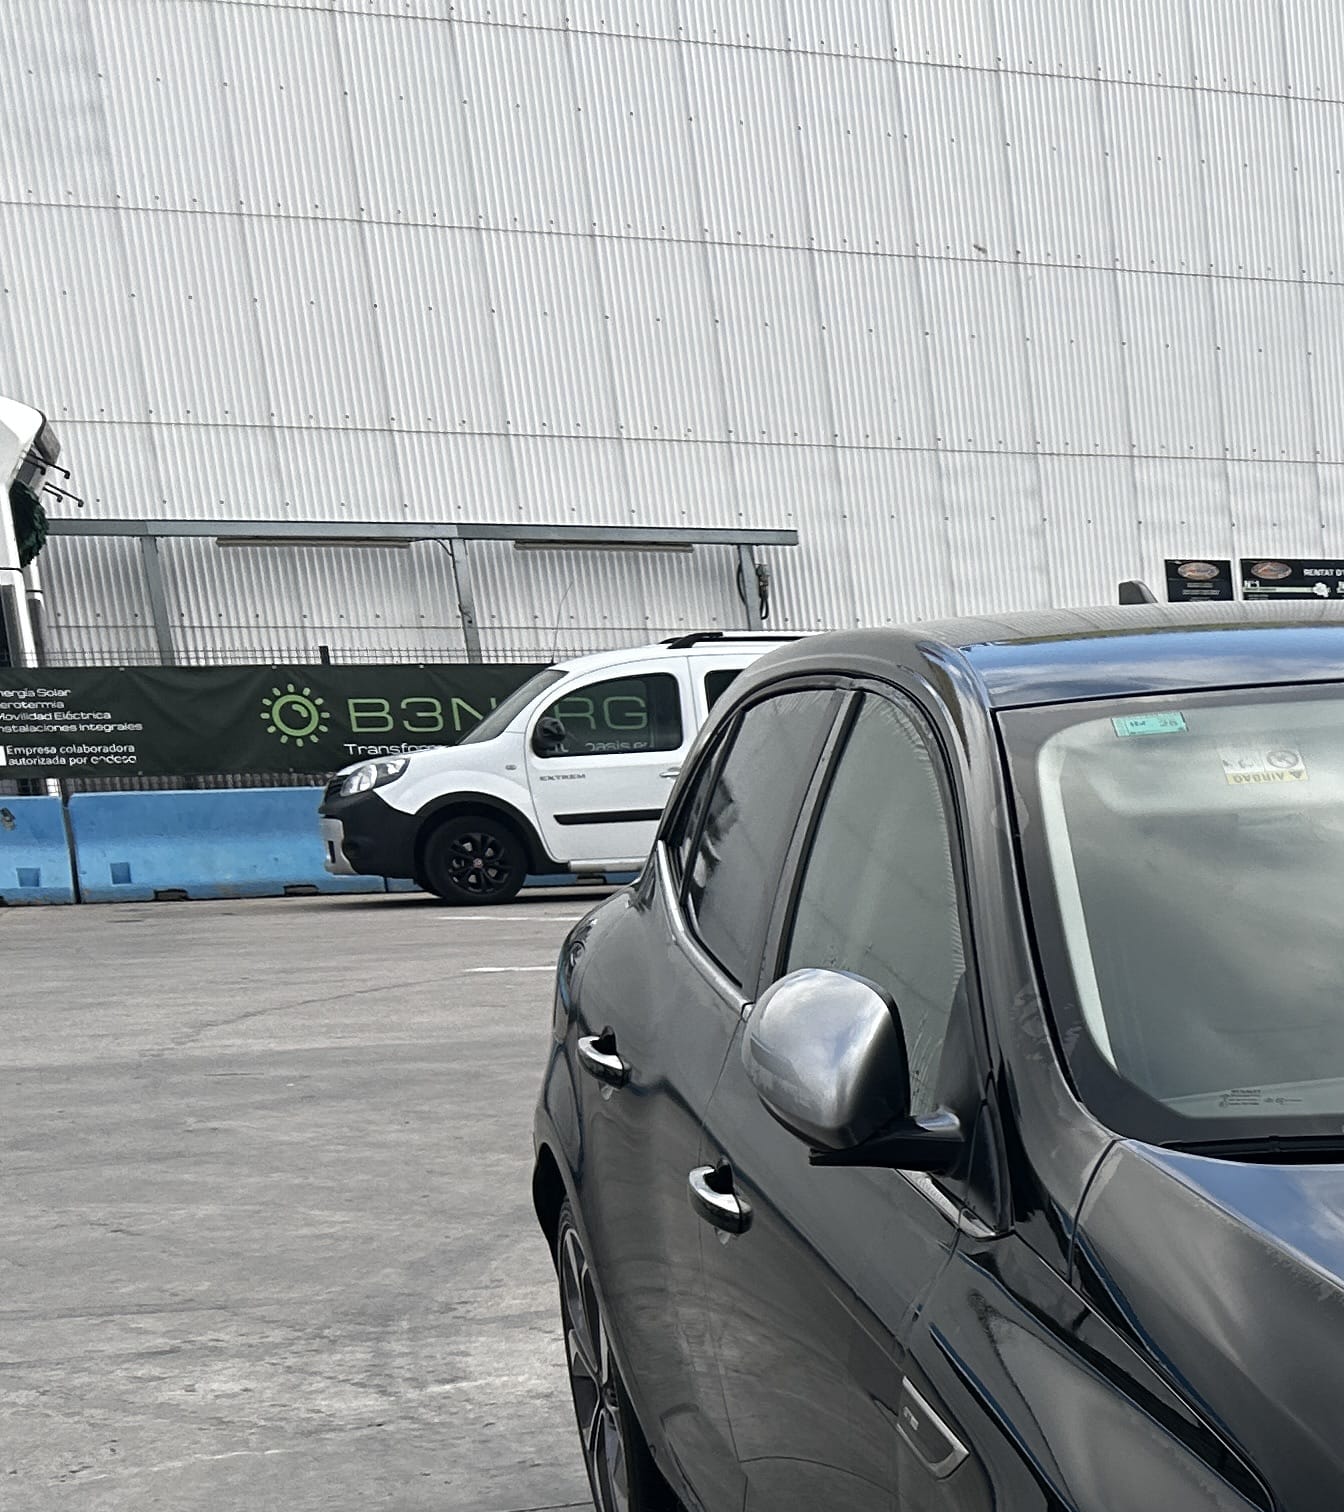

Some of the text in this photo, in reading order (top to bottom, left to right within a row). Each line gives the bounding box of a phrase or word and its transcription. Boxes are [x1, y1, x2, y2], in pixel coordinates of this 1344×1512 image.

[37, 688, 71, 698] Solar
[0, 701, 64, 709] erotermia
[54, 710, 112, 720] Eléctrica
[347, 695, 648, 733] B3NRG
[0, 723, 143, 733] nstalaciones Integrales
[6, 744, 135, 756] Empresa colaboradora
[8, 756, 66, 766] autorizada
[69, 757, 88, 766] por
